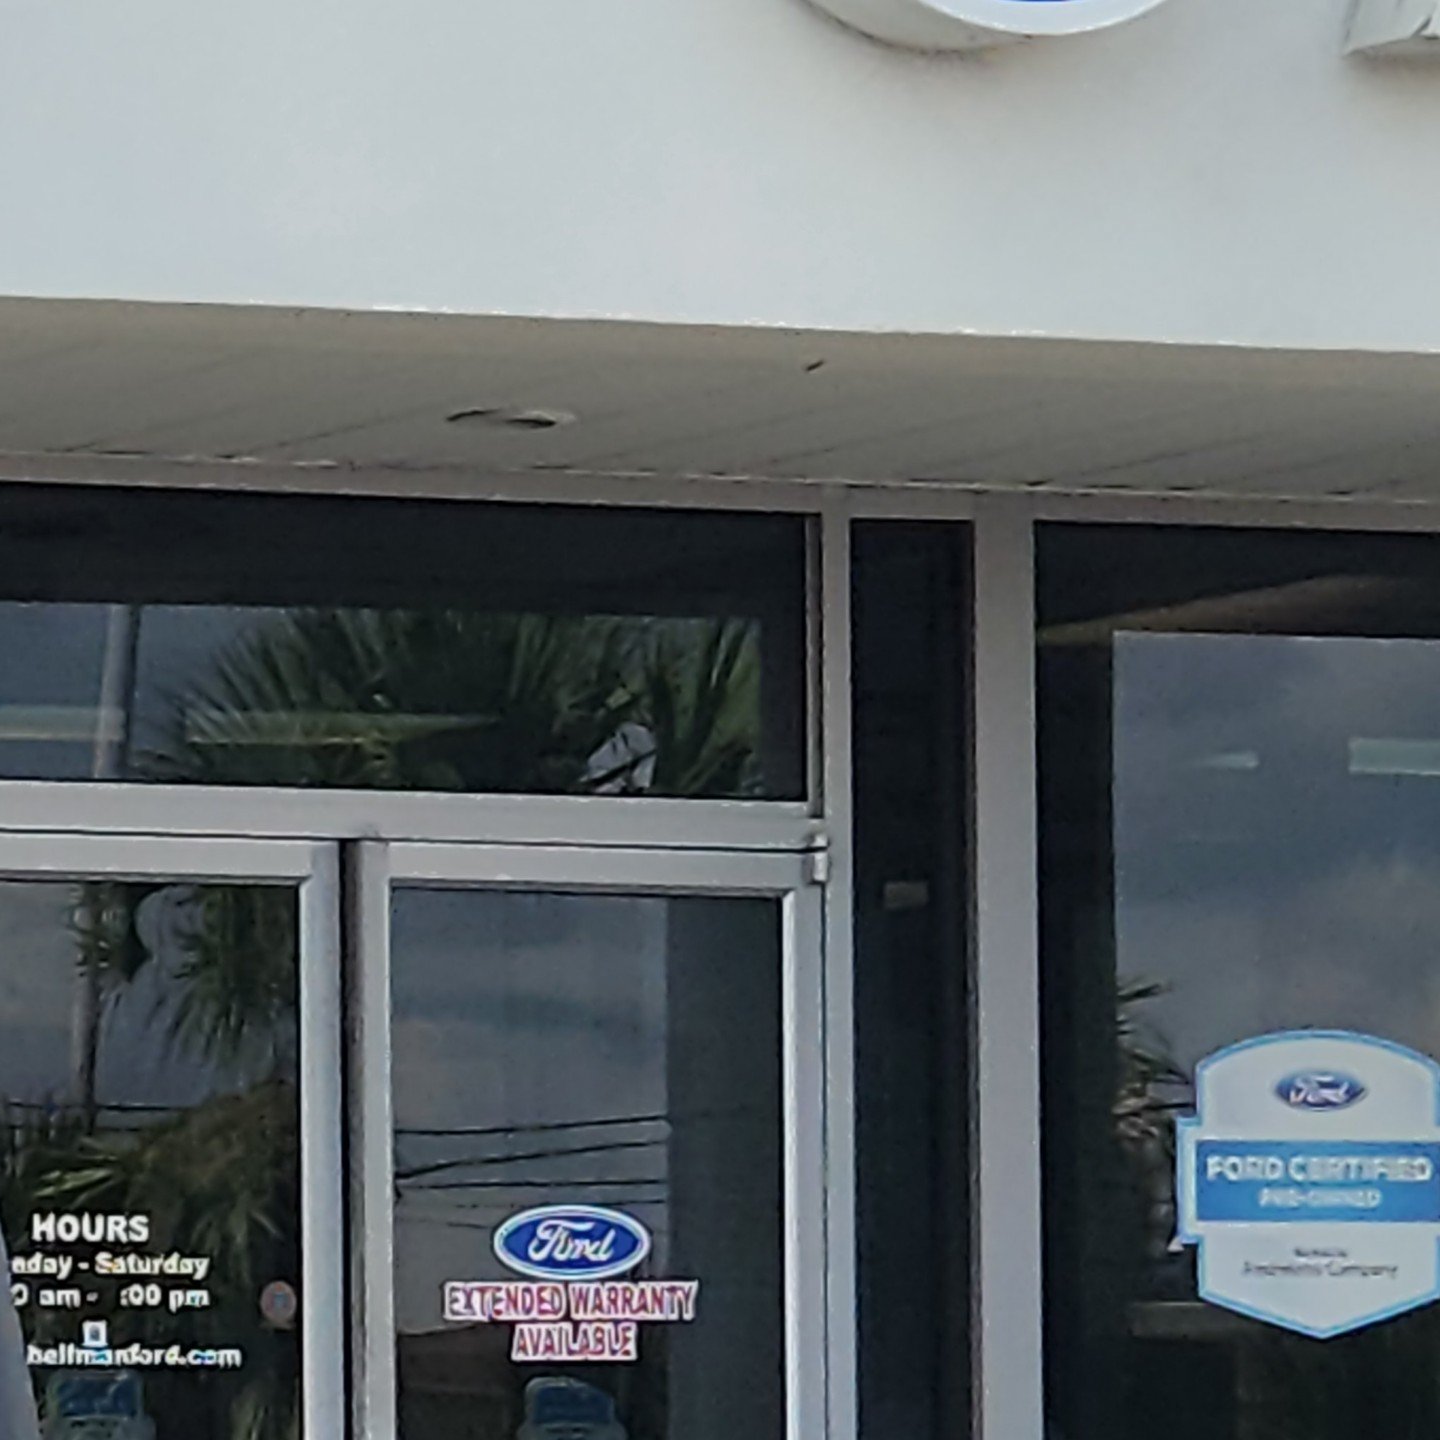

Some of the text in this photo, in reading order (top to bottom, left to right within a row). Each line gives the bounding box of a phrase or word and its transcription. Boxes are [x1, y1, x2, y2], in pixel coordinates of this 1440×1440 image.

[1206, 1156, 1282, 1181] FORD
[31, 1212, 150, 1243] HOURS
[527, 1218, 616, 1262] Ford
[94, 1251, 211, 1280] Saturday
[39, 1289, 81, 1308] am
[169, 1289, 211, 1313] pm
[446, 1282, 697, 1319] EXTENDED WARRANTY
[513, 1323, 637, 1360] AVAILABLE
